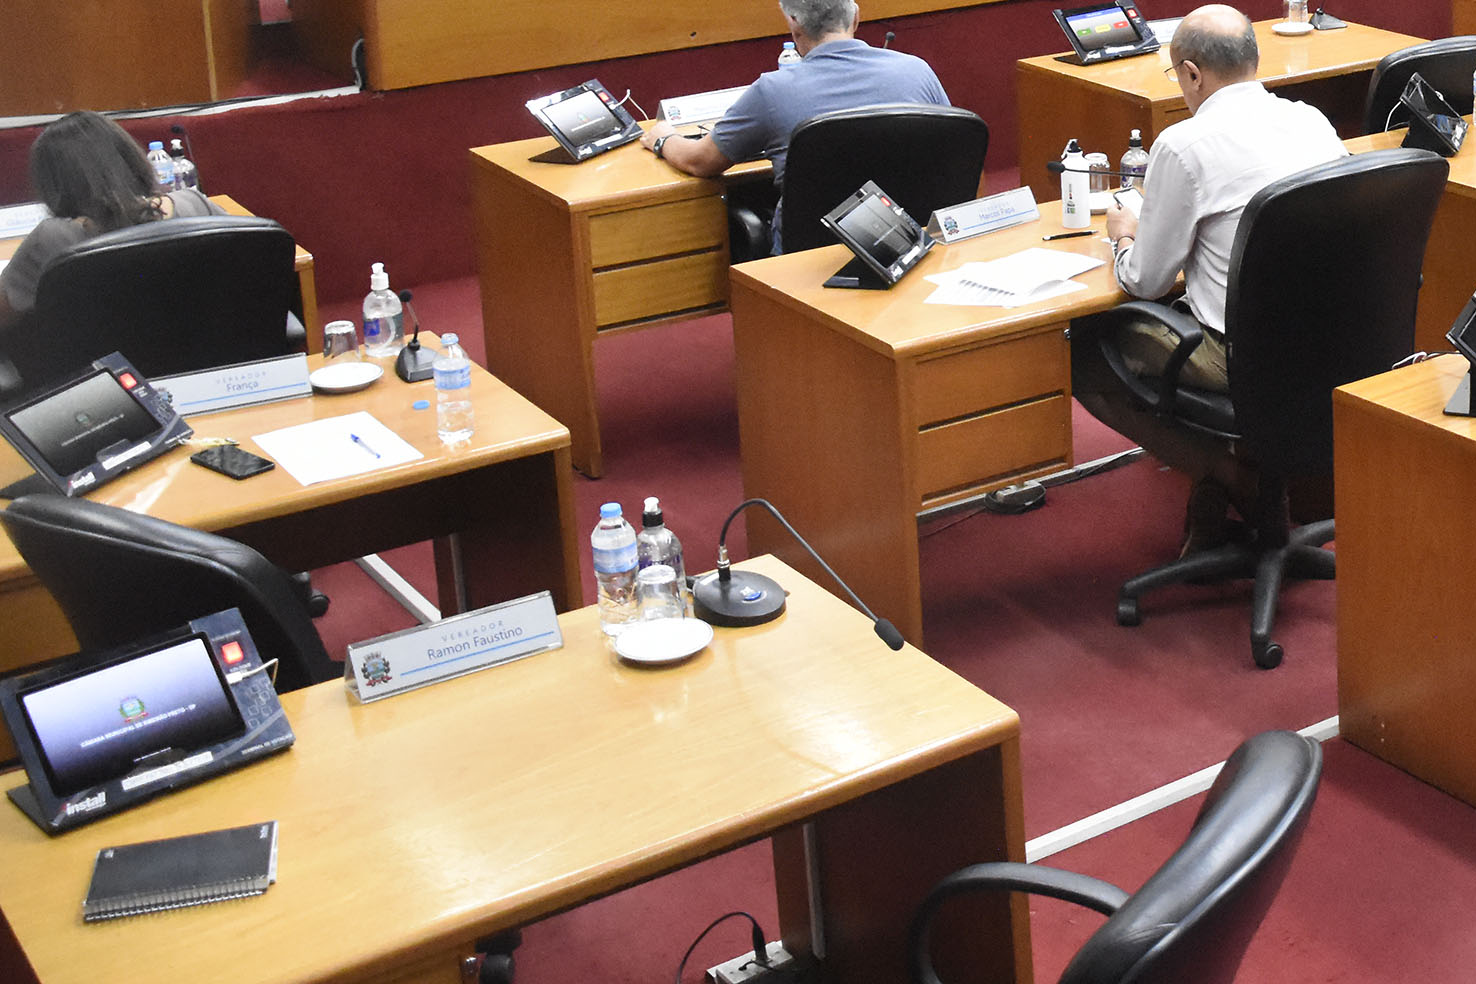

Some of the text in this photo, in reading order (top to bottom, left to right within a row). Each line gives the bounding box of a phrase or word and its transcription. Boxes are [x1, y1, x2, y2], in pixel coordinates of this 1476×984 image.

[226, 382, 259, 392] França
[441, 620, 504, 642] VEREADOR
[428, 626, 523, 660] Ramon Faustino
[66, 792, 105, 815] install
